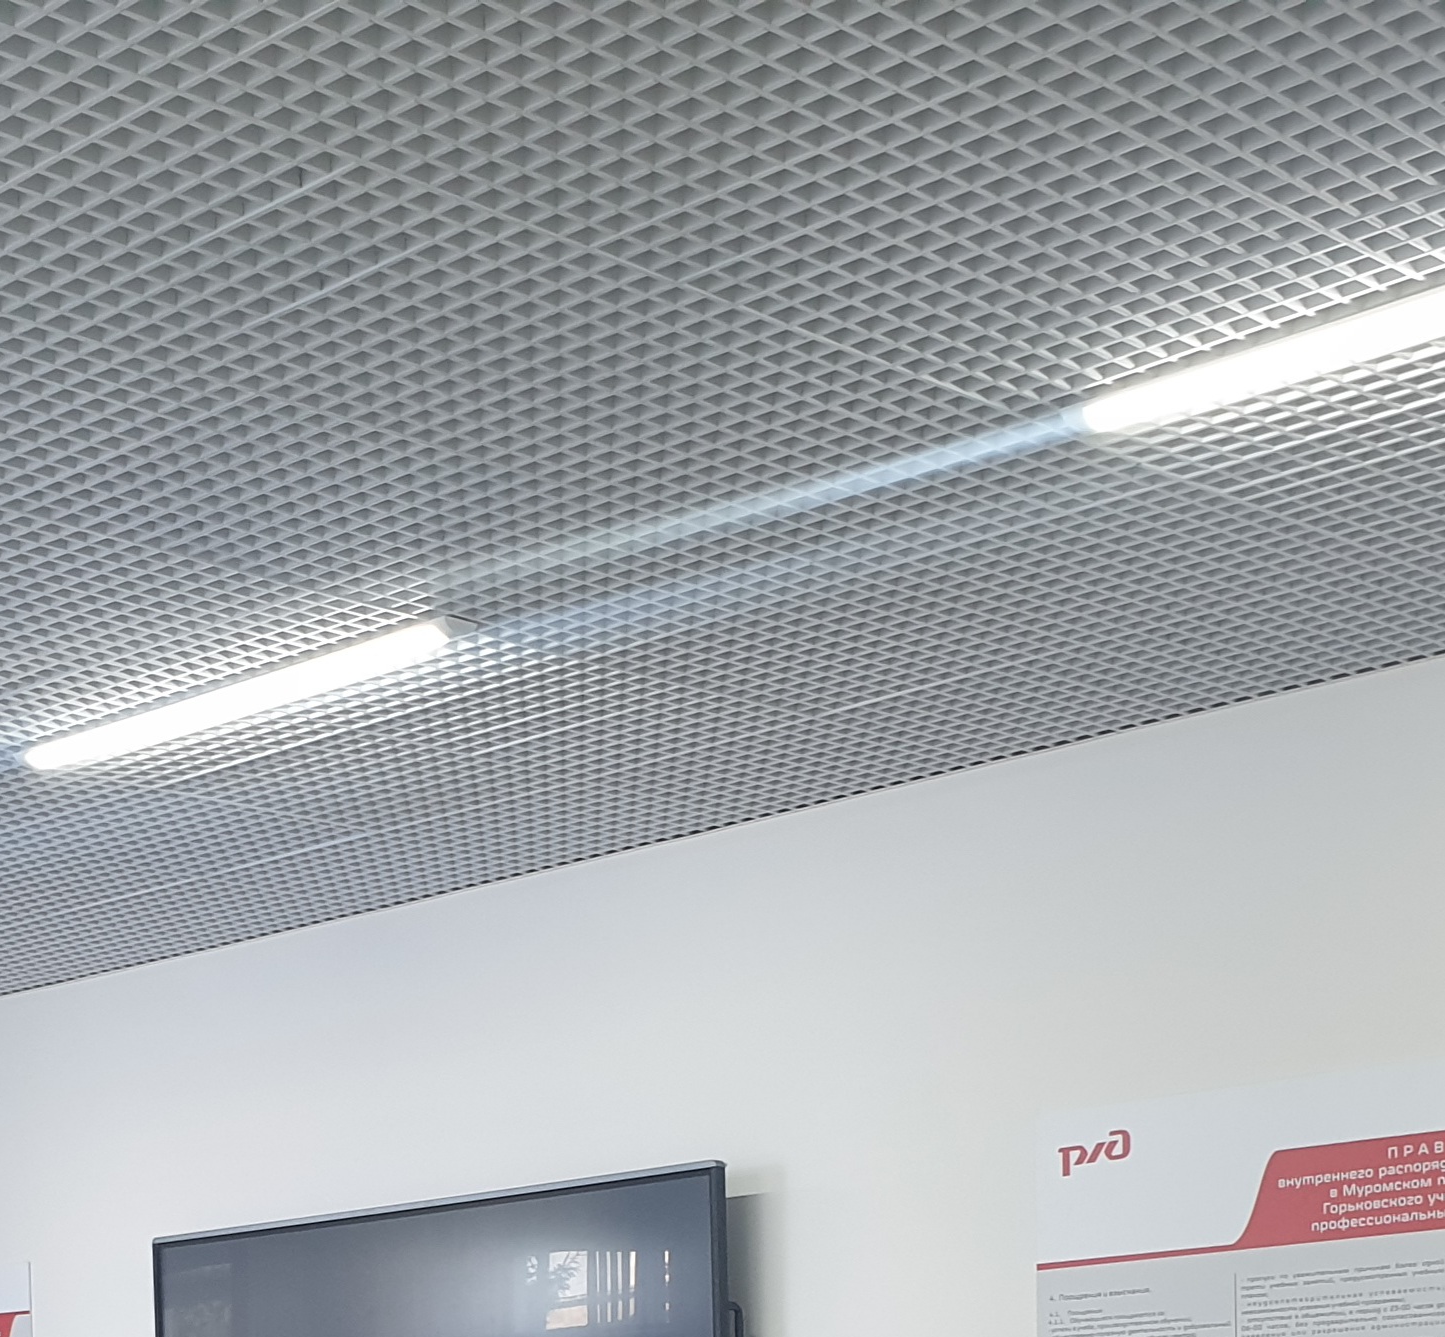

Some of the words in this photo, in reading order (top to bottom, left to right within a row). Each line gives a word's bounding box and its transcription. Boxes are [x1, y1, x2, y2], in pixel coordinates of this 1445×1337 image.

[1278, 1168, 1374, 1189] внутреннего
[1329, 1189, 1338, 1198] в
[1342, 1177, 1432, 1198] Муромском
[1323, 1194, 1424, 1215] Горьковского
